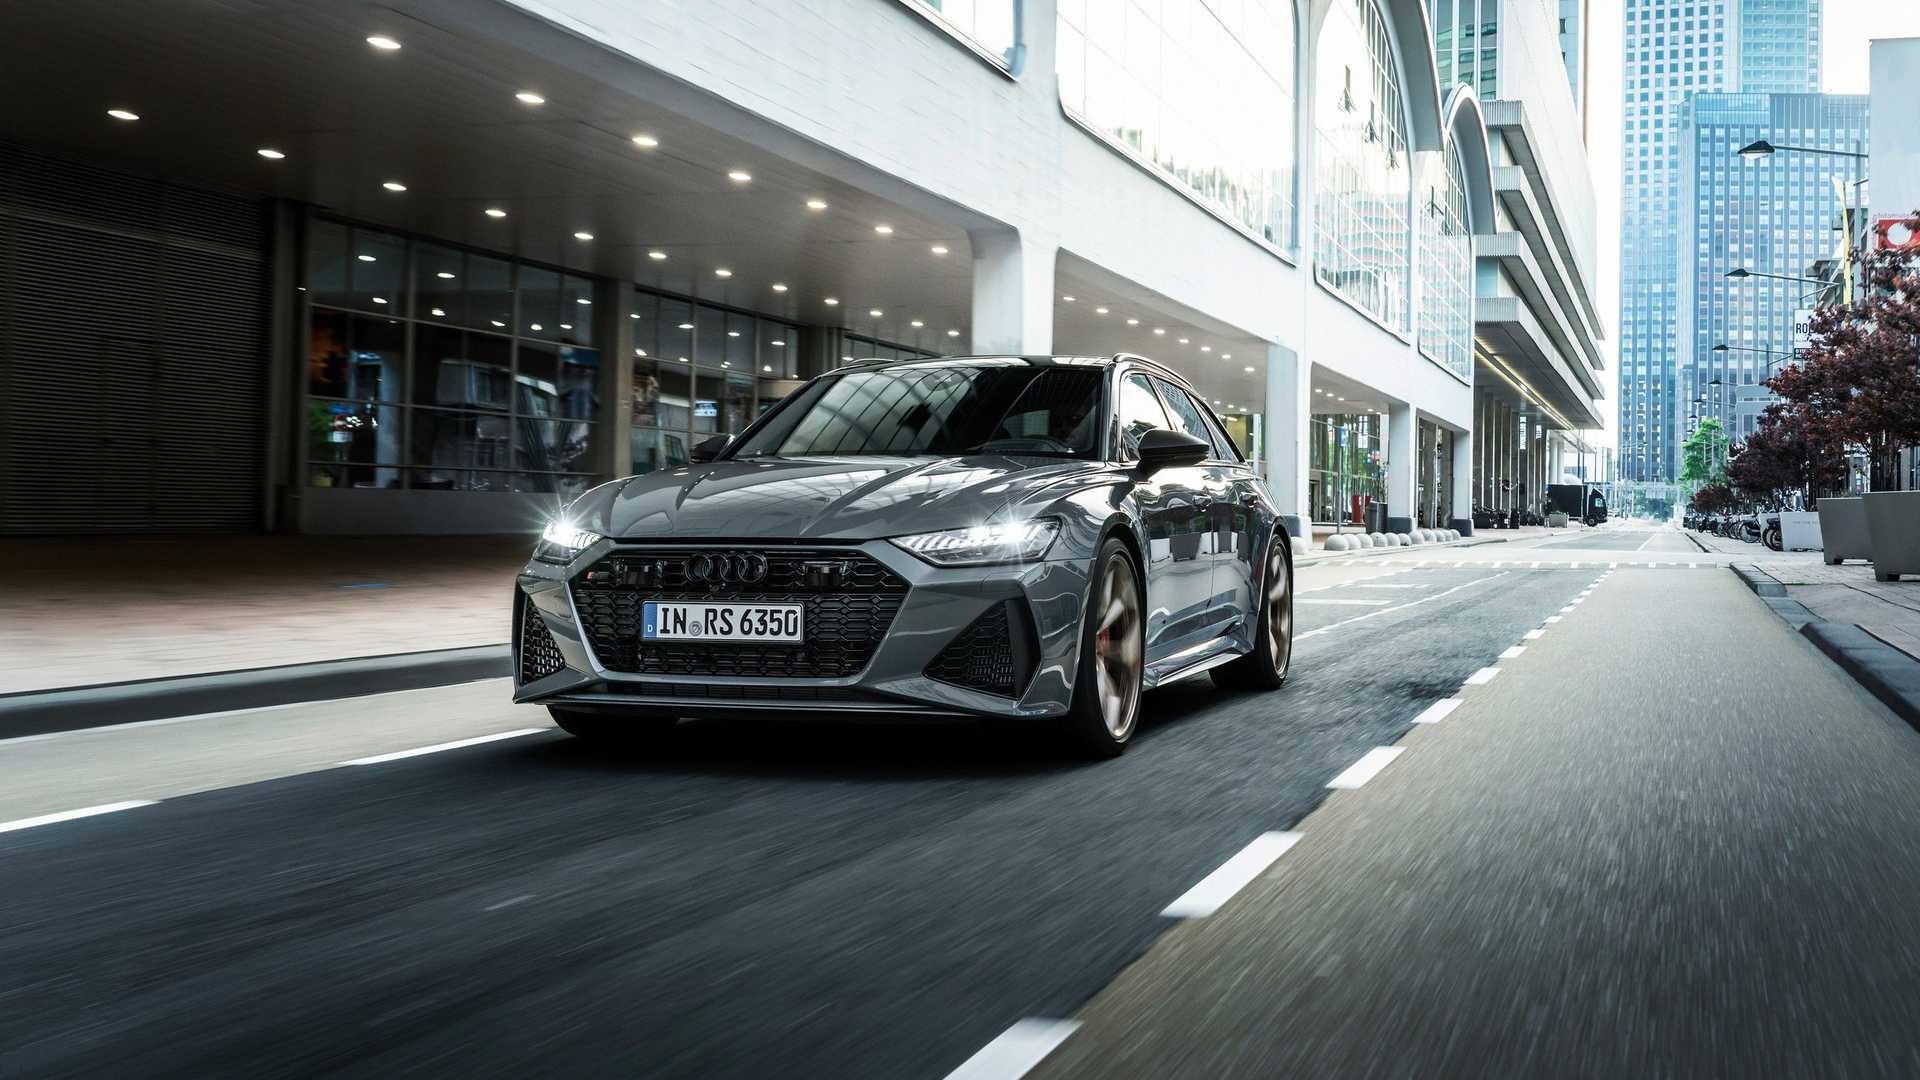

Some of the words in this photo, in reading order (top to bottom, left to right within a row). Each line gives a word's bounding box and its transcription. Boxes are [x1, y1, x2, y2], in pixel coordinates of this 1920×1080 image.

[647, 624, 653, 632] D
[660, 607, 687, 634] IN
[704, 608, 734, 635] RS
[740, 609, 798, 636] 6350
